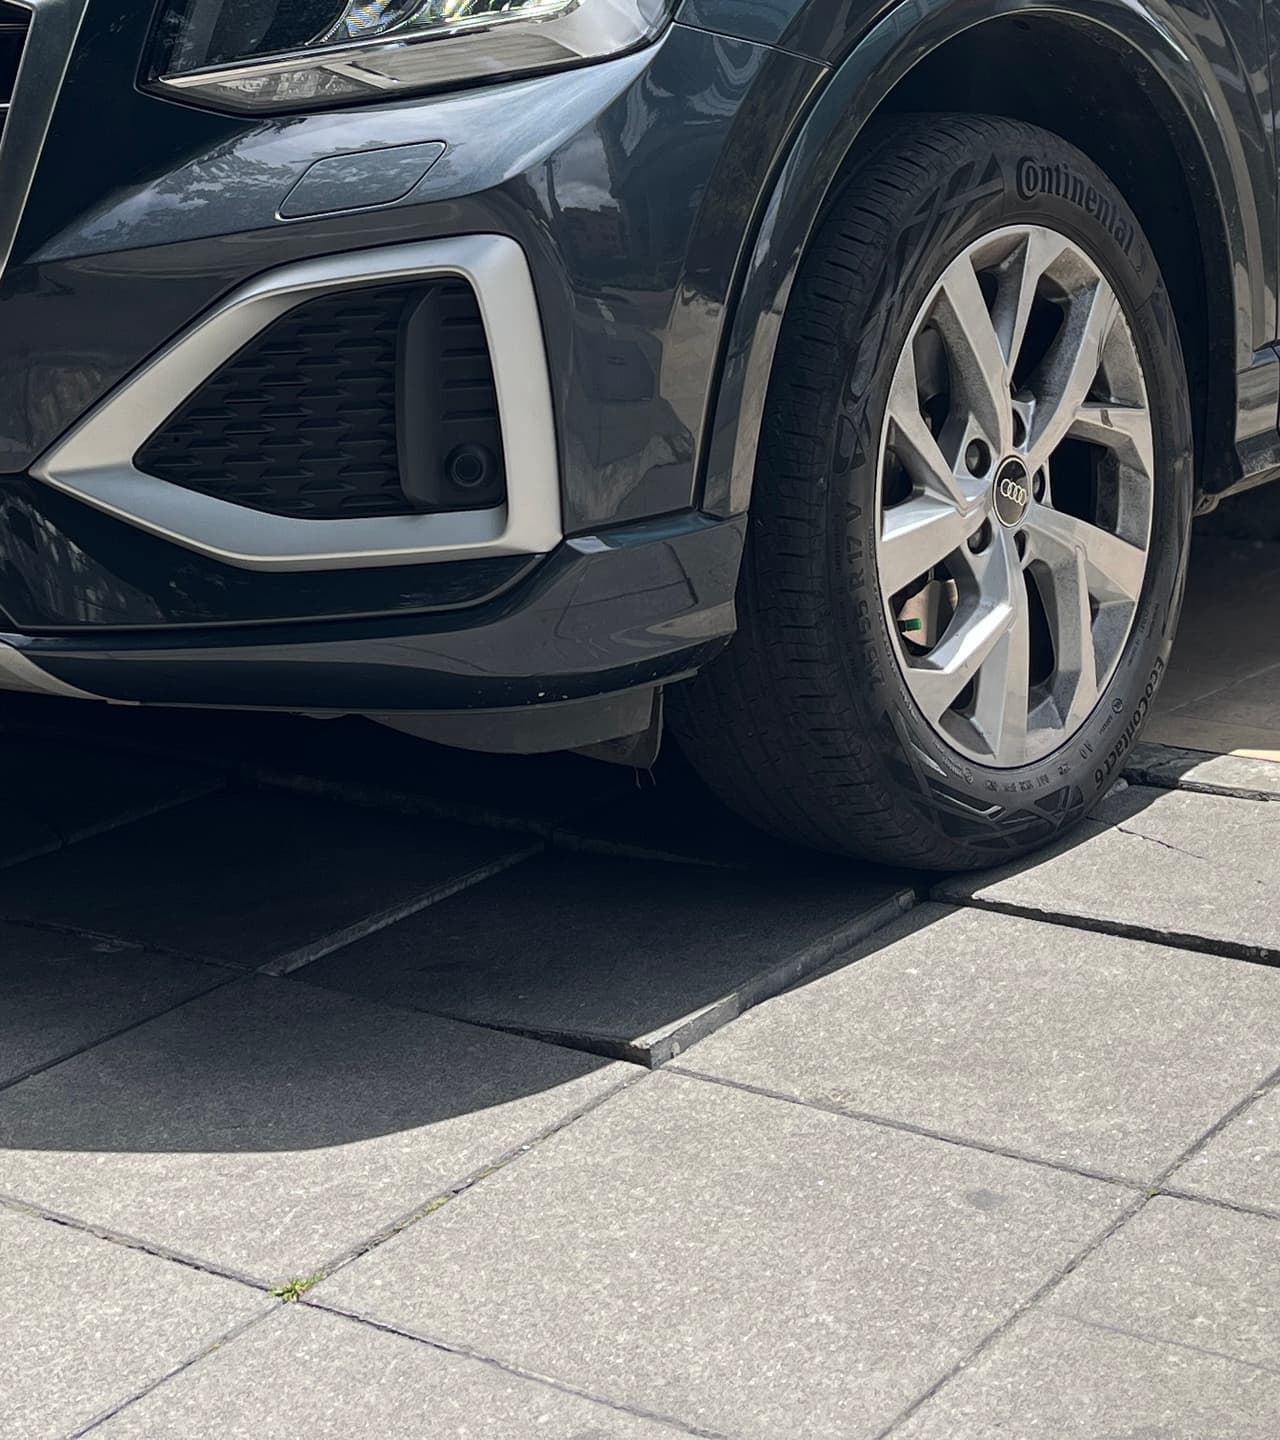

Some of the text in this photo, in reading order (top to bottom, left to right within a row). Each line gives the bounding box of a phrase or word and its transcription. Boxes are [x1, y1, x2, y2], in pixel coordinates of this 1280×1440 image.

[1017, 156, 1135, 256] Continental
[1105, 655, 1164, 776] EcoContact
[1094, 769, 1105, 791] 6
